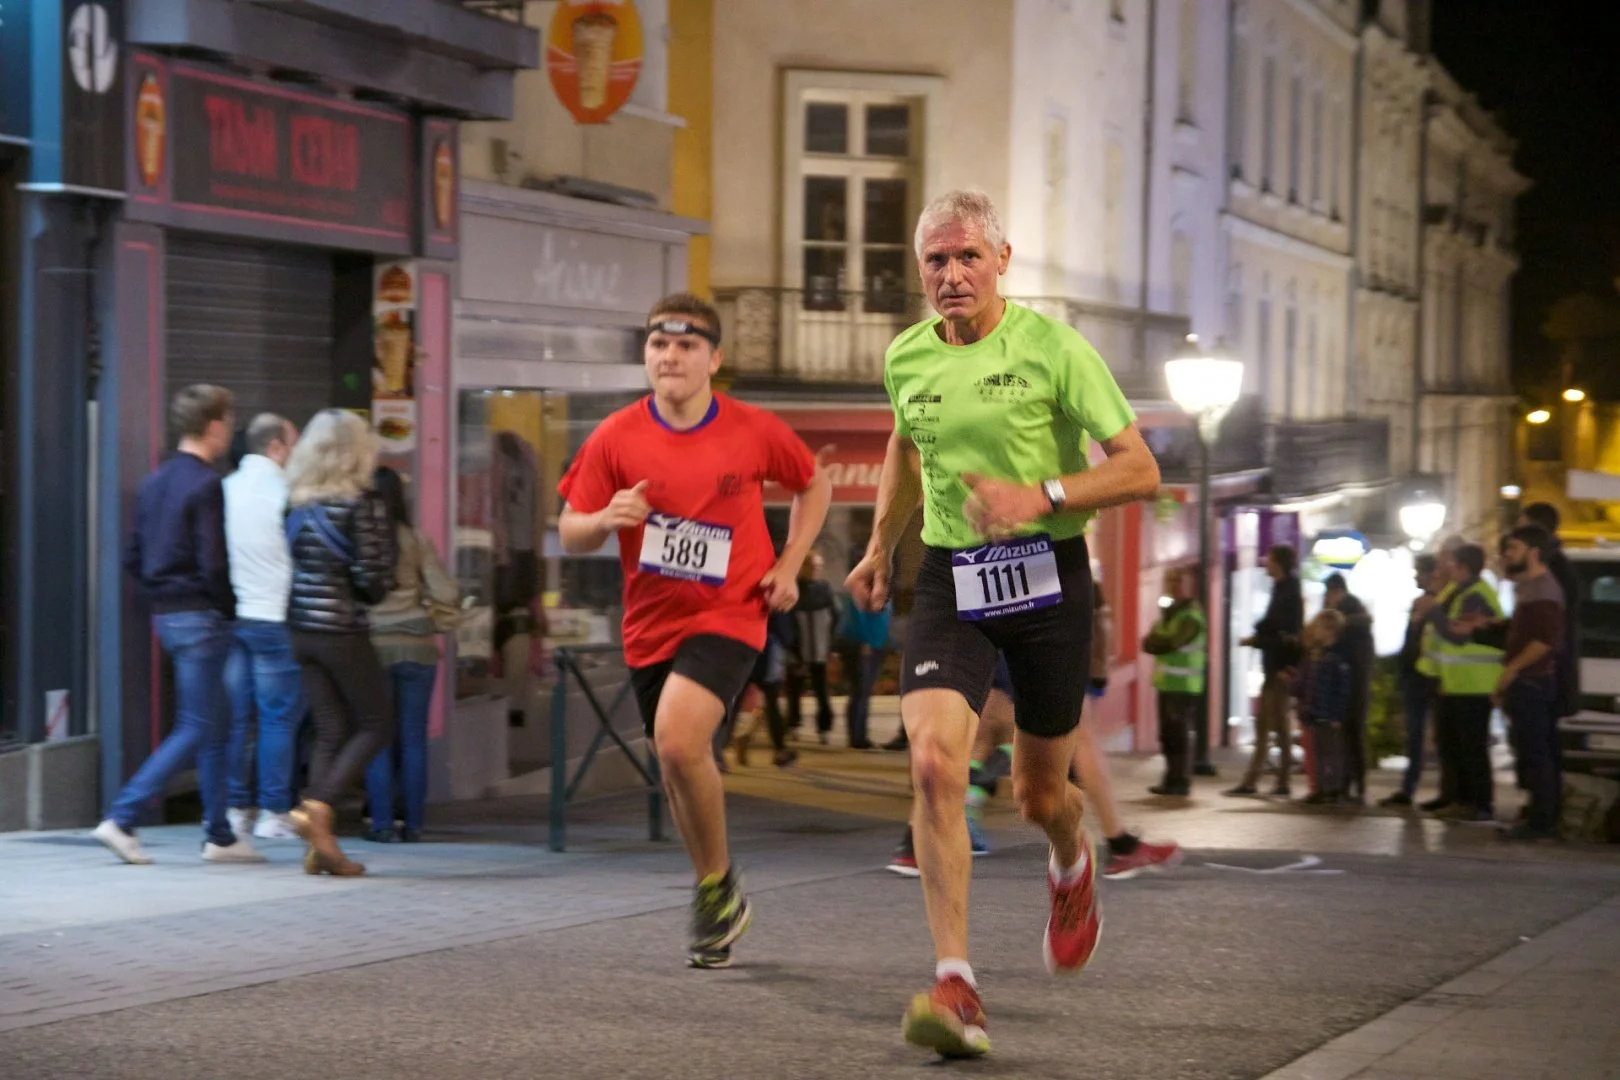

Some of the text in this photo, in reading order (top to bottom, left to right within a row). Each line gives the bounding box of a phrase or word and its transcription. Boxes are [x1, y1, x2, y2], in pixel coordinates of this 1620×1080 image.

[661, 534, 708, 569] 589
[977, 561, 1029, 603] 1111
[984, 602, 1034, 617] www.mizuno.fr
